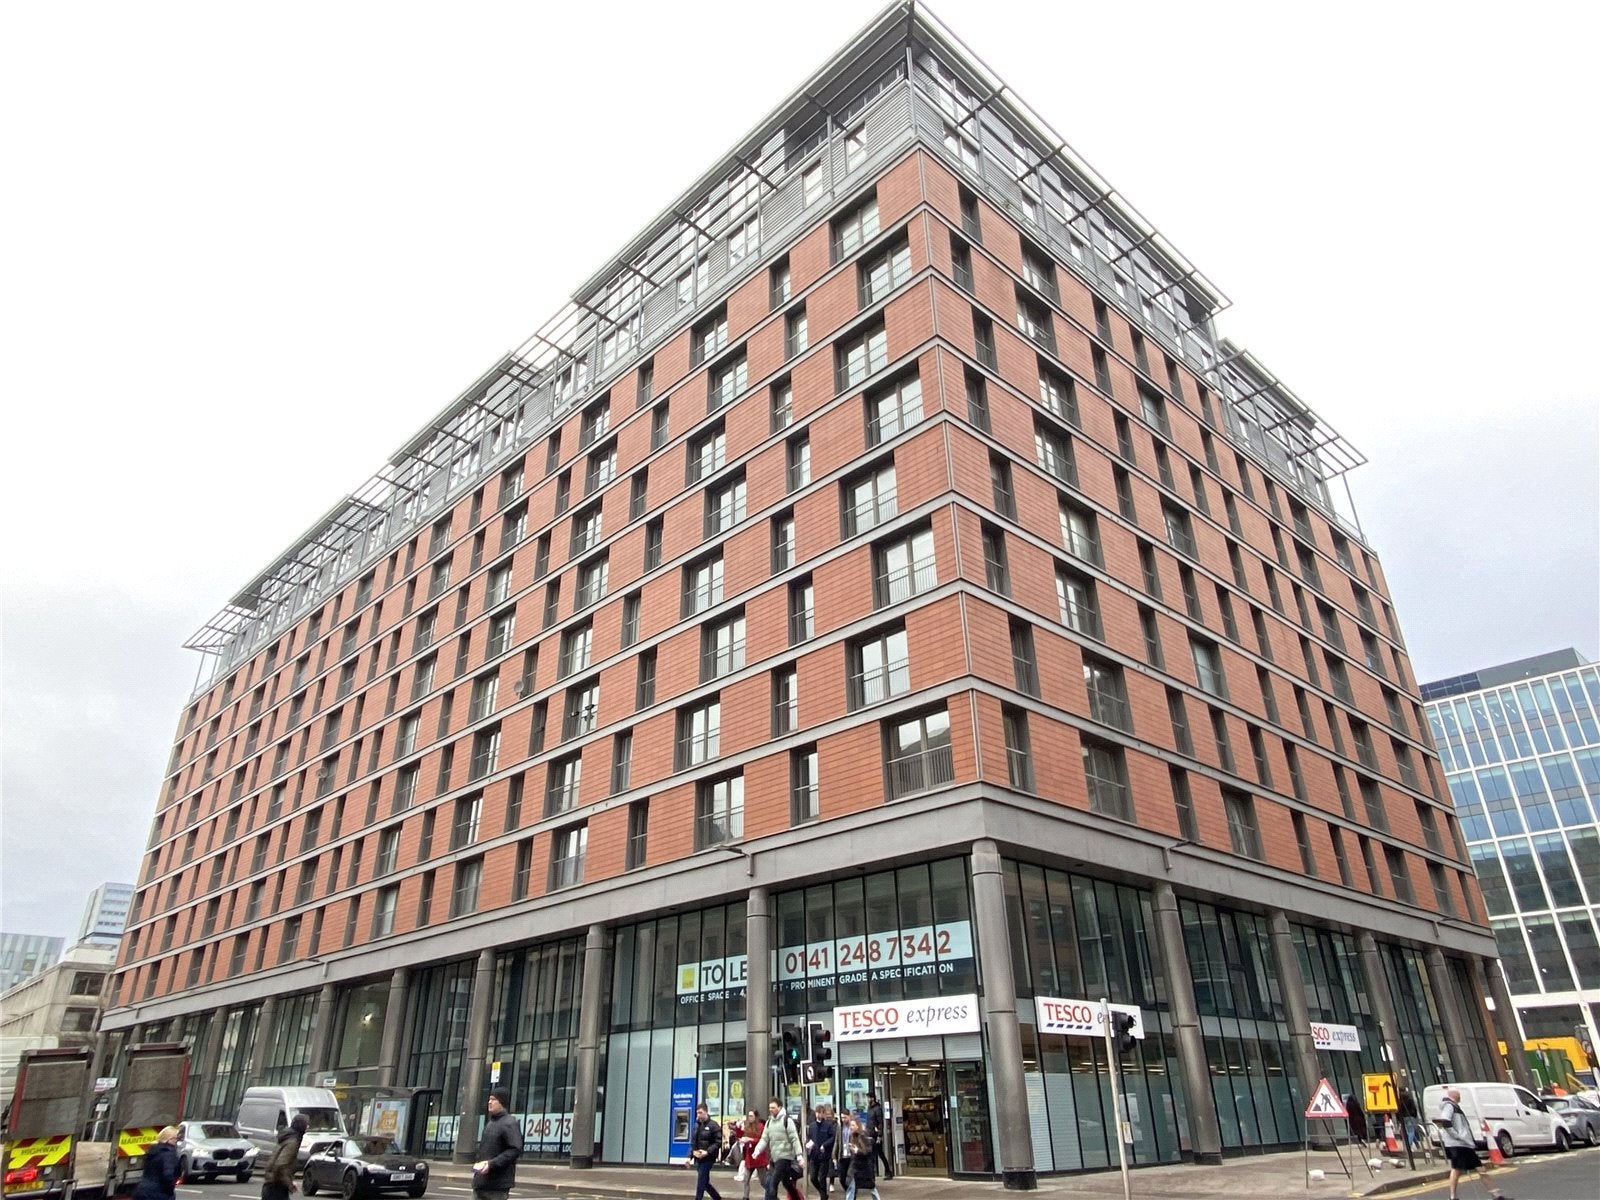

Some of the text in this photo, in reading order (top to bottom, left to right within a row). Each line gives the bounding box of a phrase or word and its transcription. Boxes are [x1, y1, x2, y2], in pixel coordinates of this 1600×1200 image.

[785, 930, 952, 974] 0141 248 7342
[702, 961, 748, 986] TO LE
[790, 976, 836, 991] PROMINENT
[839, 972, 868, 985] GRADE
[871, 971, 879, 981] A
[879, 962, 954, 980] SPECIFICATION
[680, 994, 705, 1005] OFFICE
[707, 990, 730, 1002] SPACE
[839, 1005, 969, 1029] TESCO express
[1043, 1002, 1092, 1024] TESCO
[1312, 1026, 1356, 1045] SCO express
[527, 1118, 552, 1138] 248
[554, 1117, 572, 1138] 73
[20, 1145, 60, 1156] HIGHWAY
[120, 1135, 157, 1145] MAINTENA
